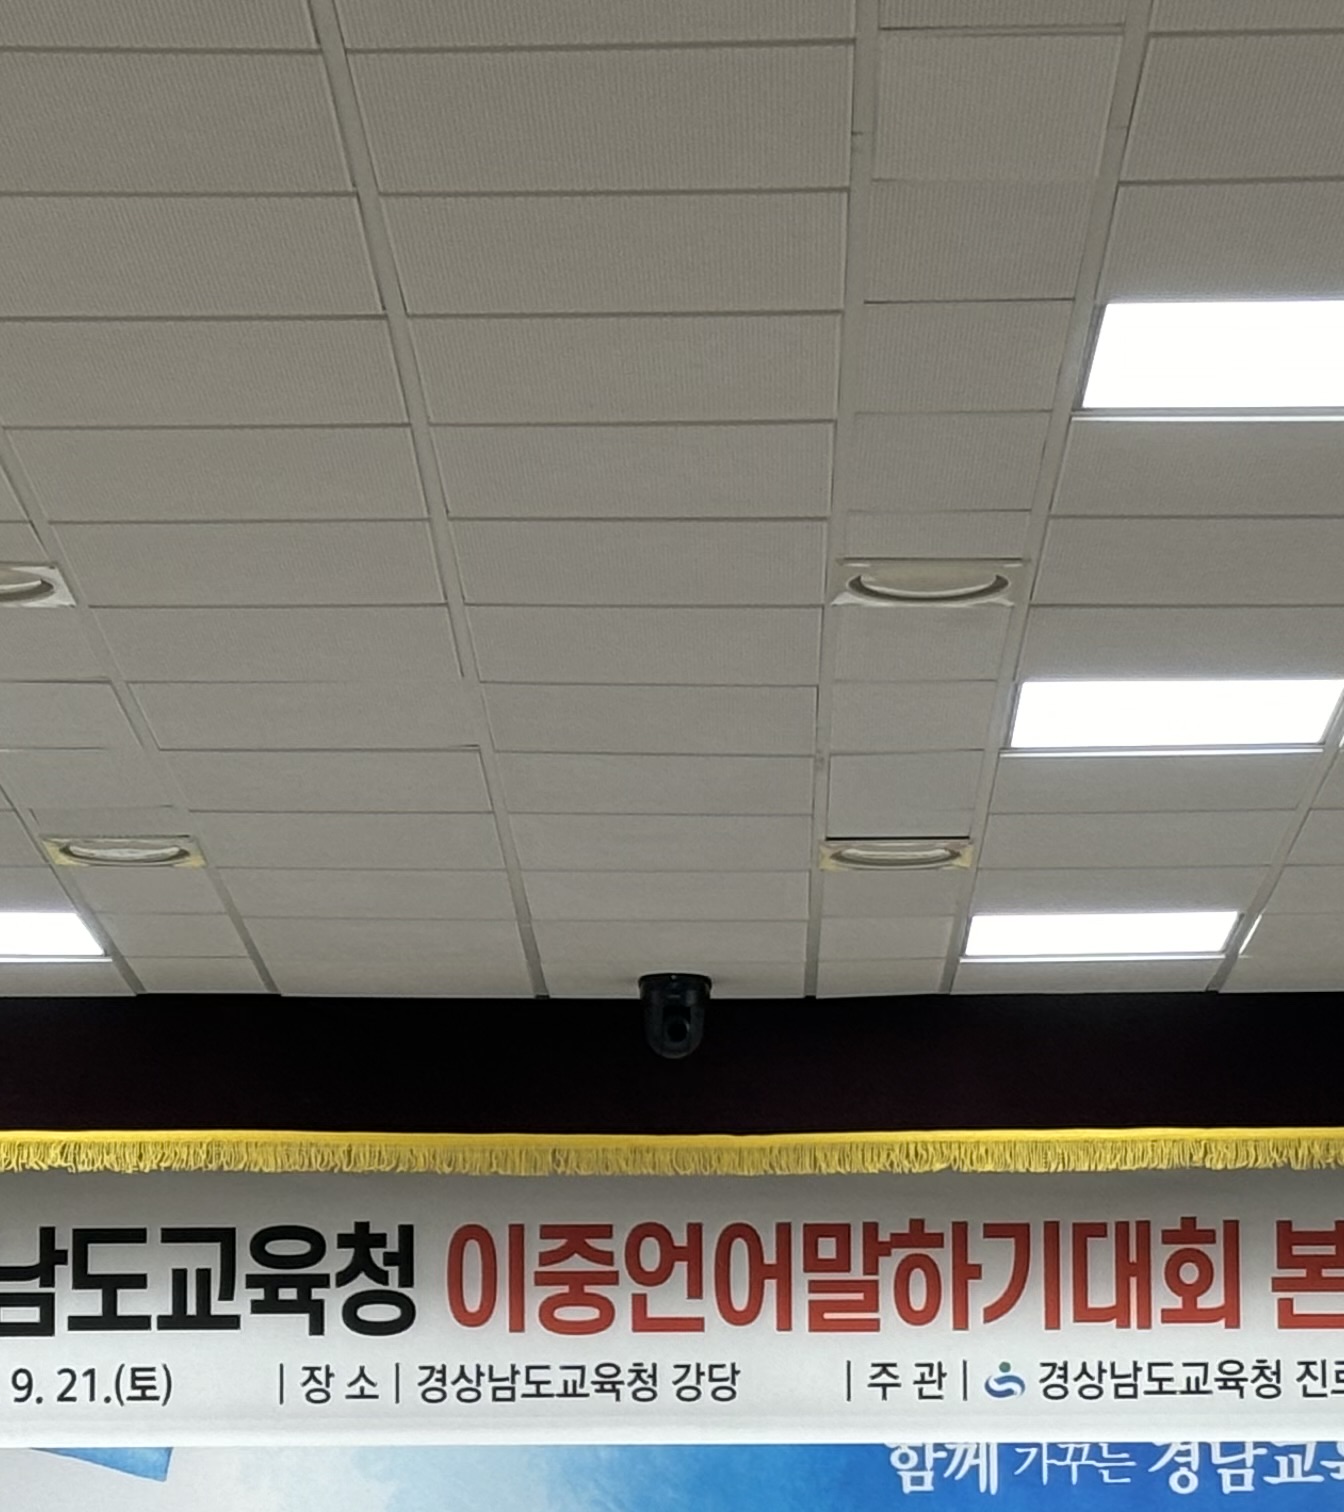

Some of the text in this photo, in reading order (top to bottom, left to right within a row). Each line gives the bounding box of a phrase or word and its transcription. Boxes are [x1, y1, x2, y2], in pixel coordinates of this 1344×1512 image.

[447, 1217, 1240, 1336] 이중언어말하기대회
[416, 1361, 742, 1404] 경상남도교육청 강당
[1038, 1358, 1283, 1400] 경상남도교육청
[1014, 1442, 1136, 1486] 가꾸는
